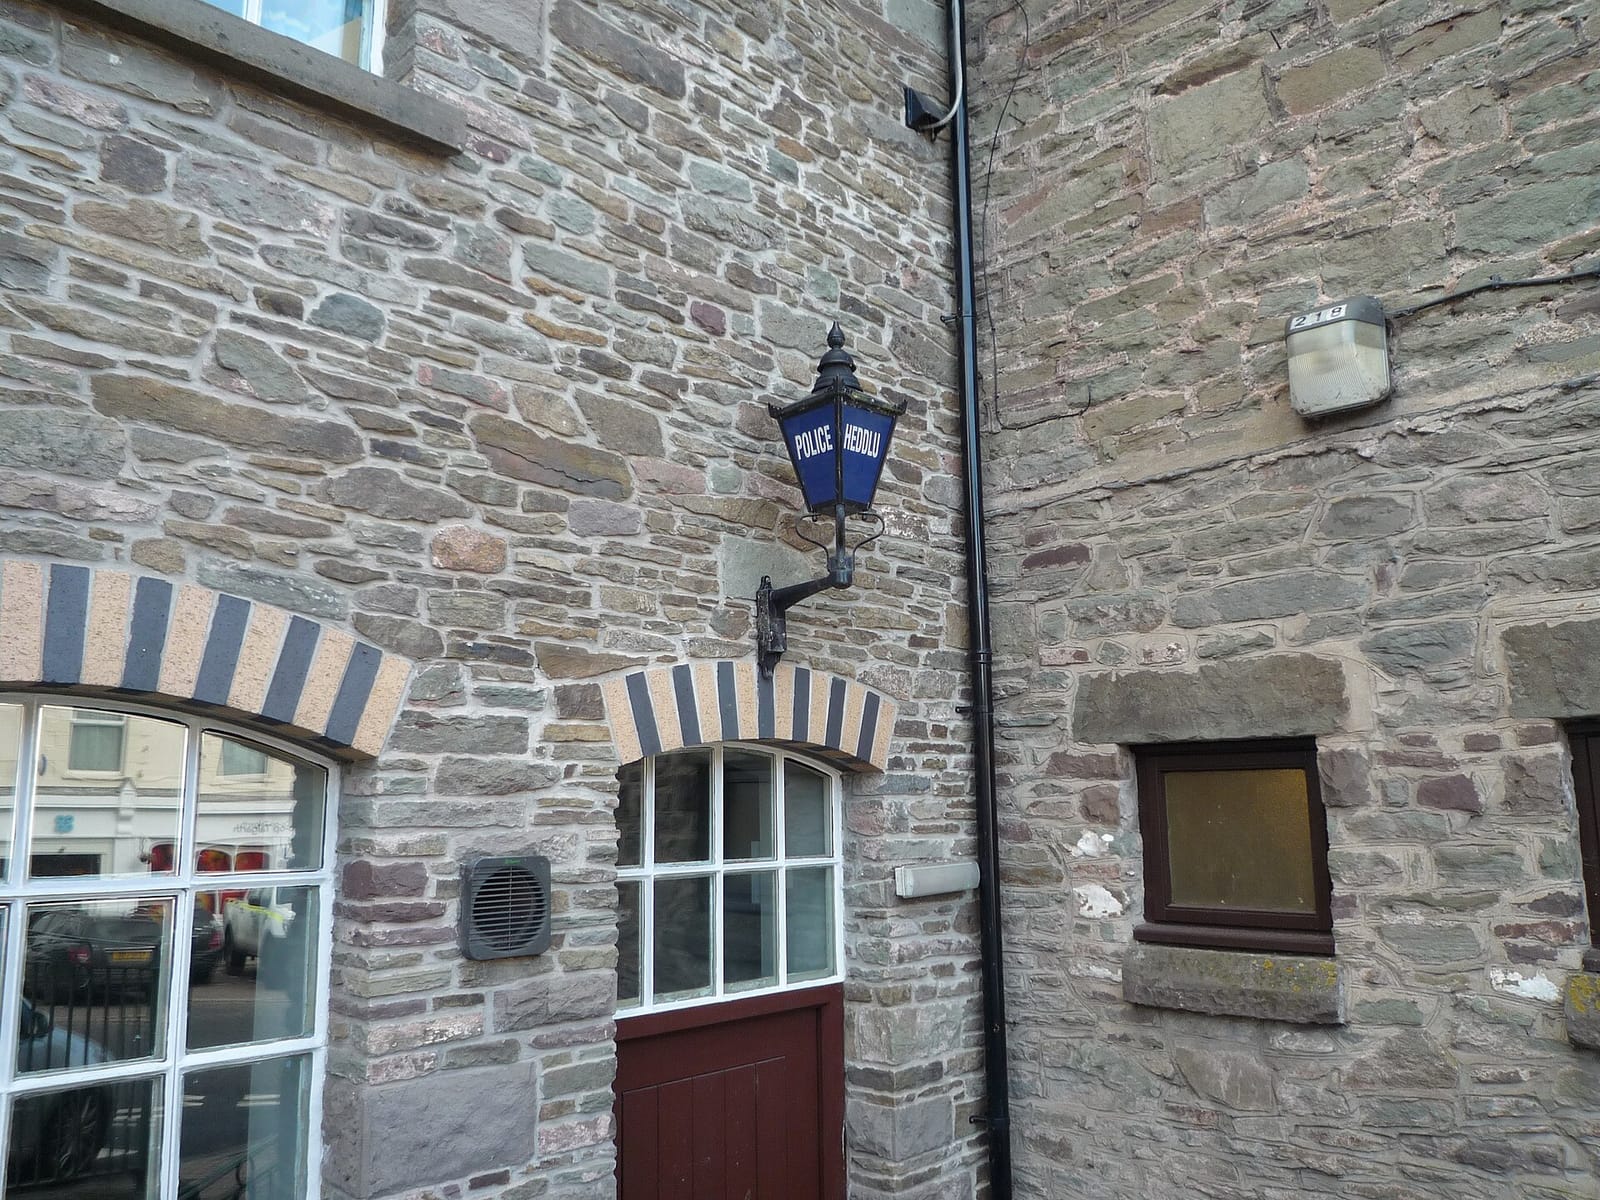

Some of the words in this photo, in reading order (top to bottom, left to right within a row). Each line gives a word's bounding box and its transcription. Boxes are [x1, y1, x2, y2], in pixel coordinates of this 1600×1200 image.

[1294, 306, 1343, 327] 218
[795, 424, 833, 460] POLICE
[843, 423, 881, 458] HEDDLU
